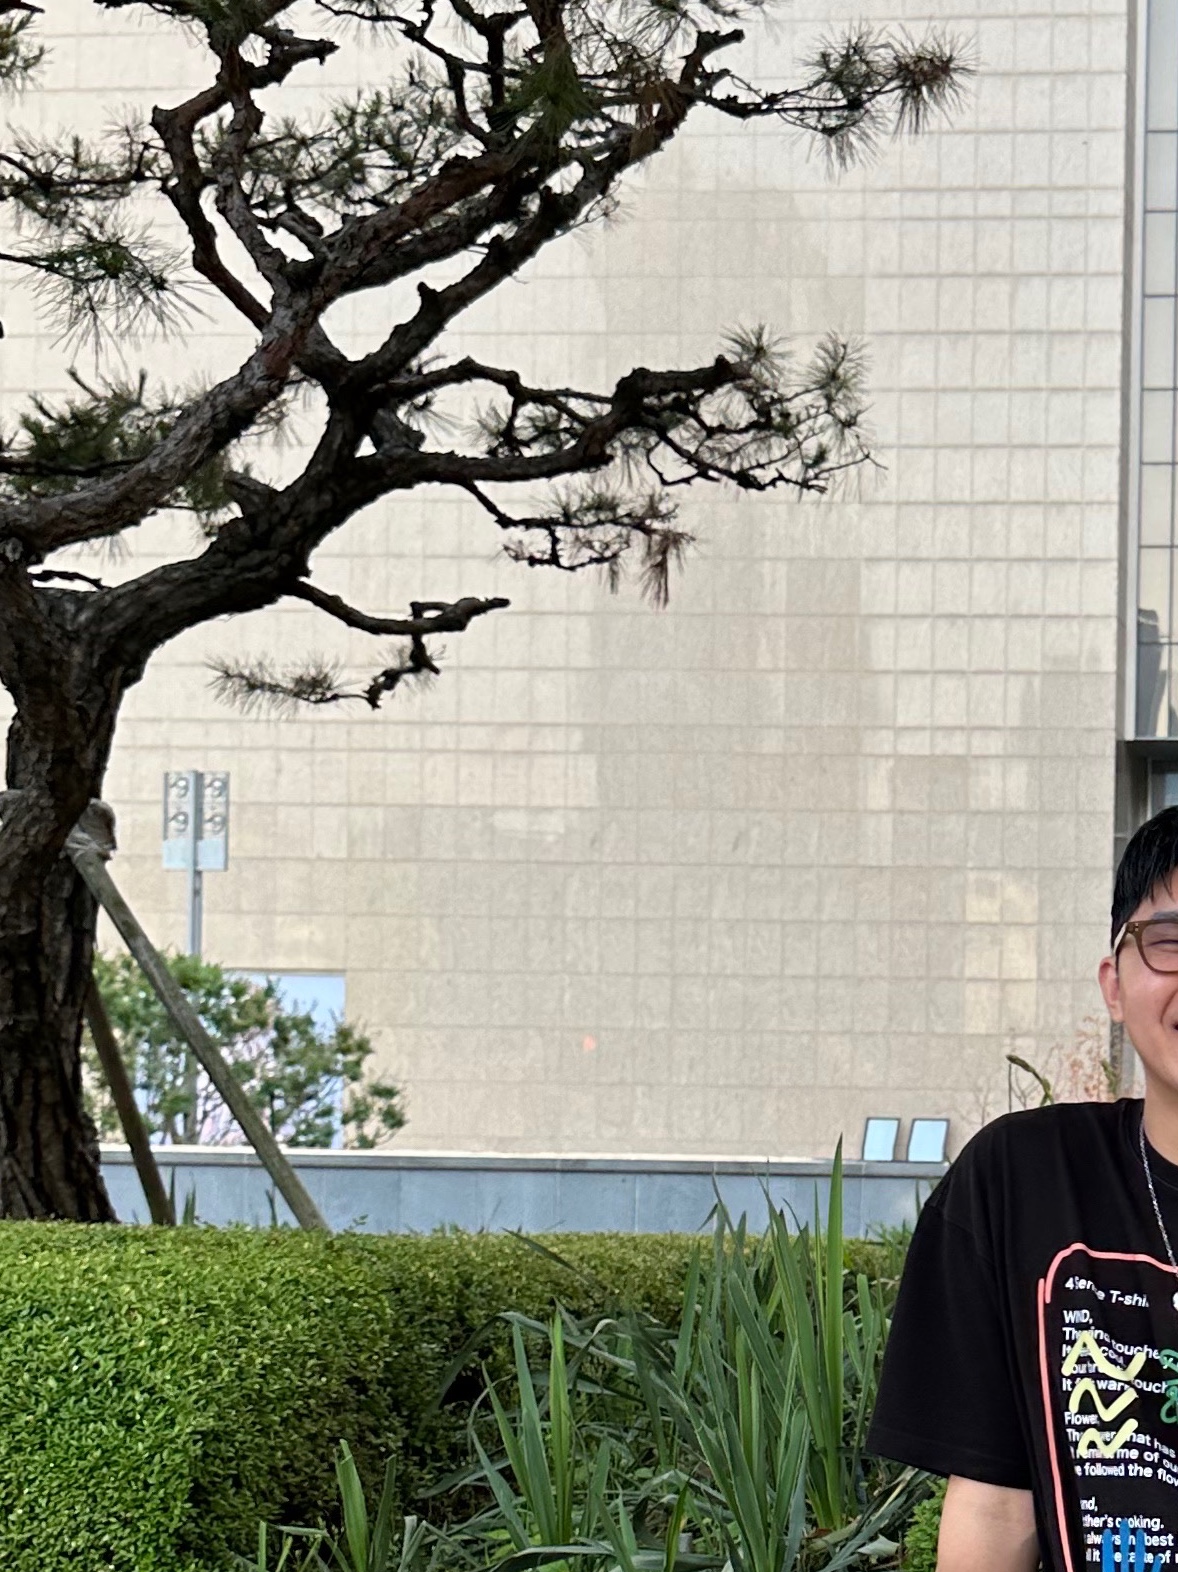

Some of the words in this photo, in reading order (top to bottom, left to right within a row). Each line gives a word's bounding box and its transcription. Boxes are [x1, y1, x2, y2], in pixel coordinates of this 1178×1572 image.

[1109, 1289, 1150, 1308] T-shi
[1062, 1326, 1081, 1341] Th
[1111, 1339, 1161, 1360] touche
[1061, 1377, 1073, 1392] It
[1116, 1448, 1140, 1460] me
[1143, 1451, 1160, 1464] of
[1084, 1461, 1125, 1477] followed
[1127, 1462, 1153, 1478] the
[1115, 1514, 1165, 1532] coking.
[1144, 1532, 1175, 1547] best
